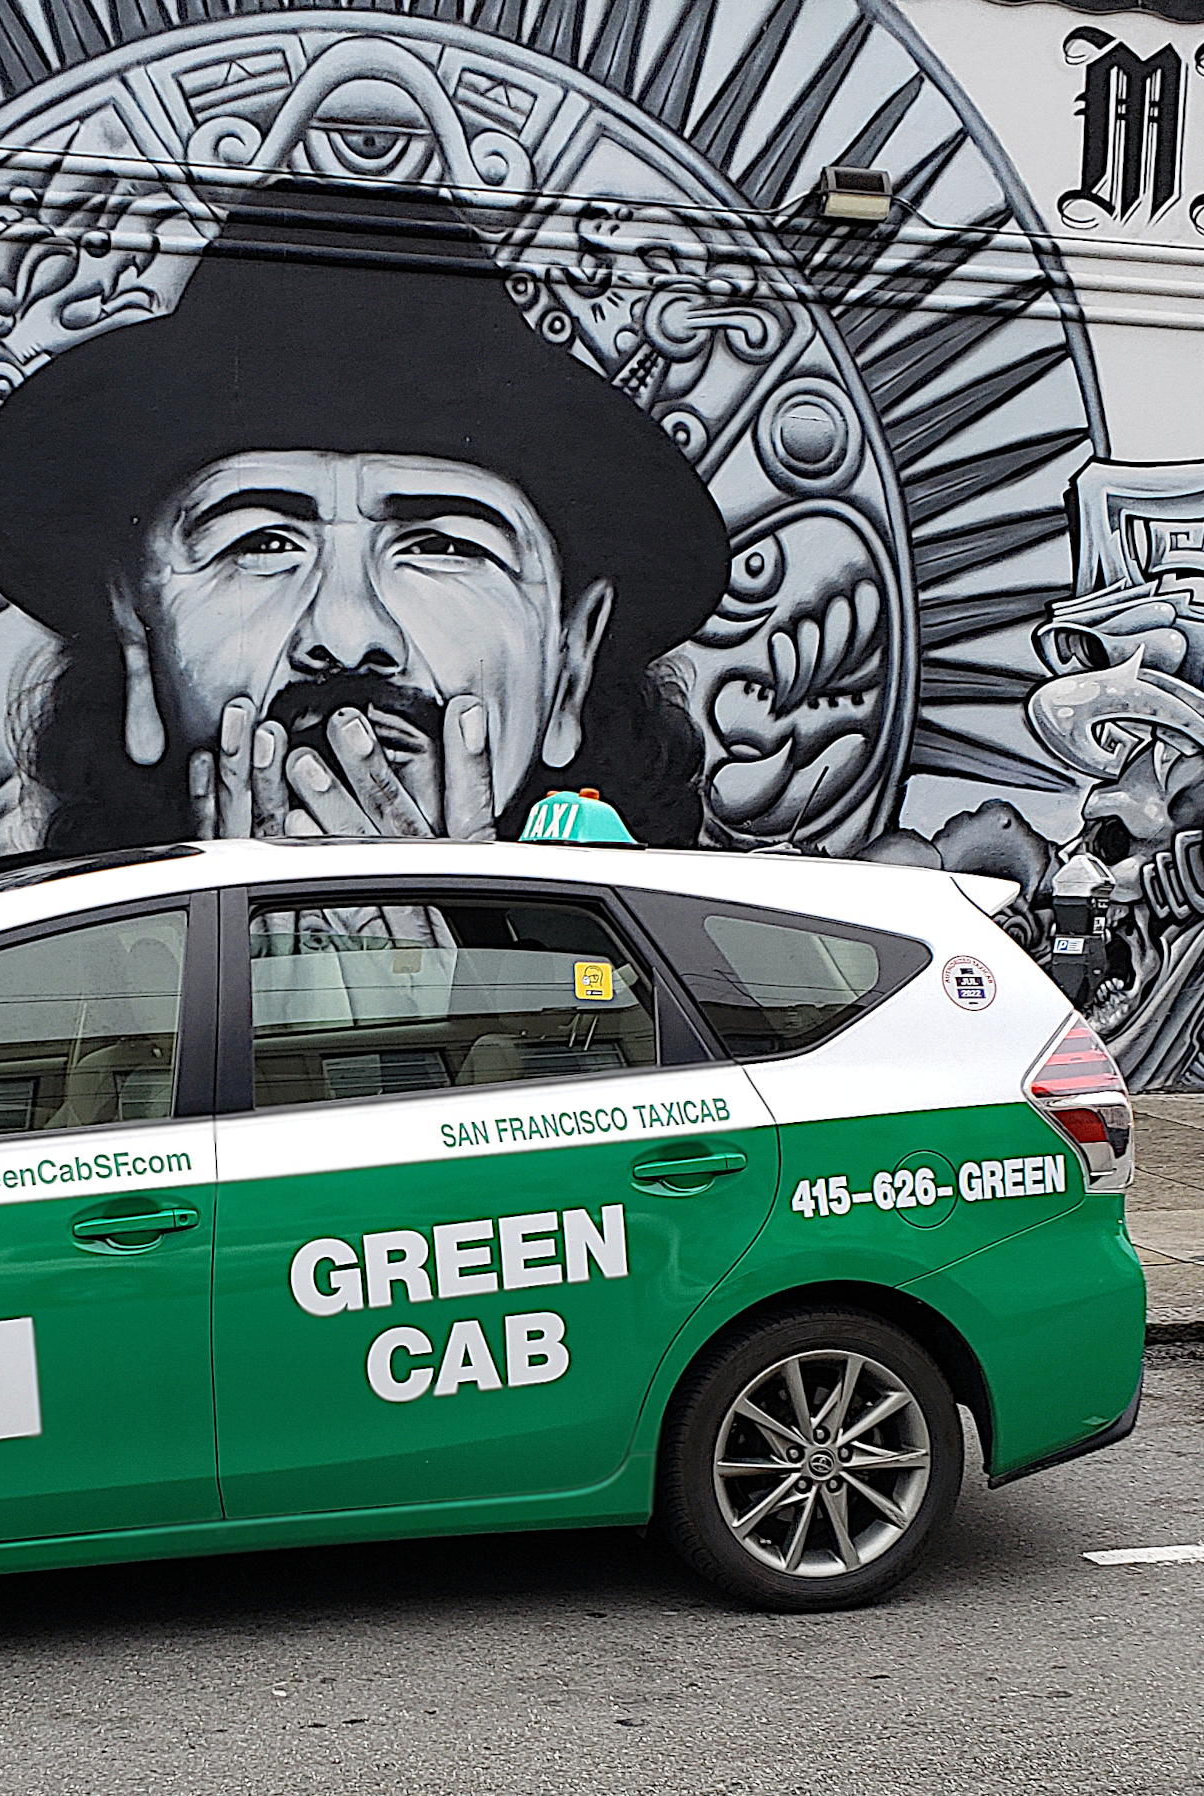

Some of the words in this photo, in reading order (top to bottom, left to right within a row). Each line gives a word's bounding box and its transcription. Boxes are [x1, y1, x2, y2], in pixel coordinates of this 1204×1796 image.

[523, 802, 580, 839] TAXI
[960, 977, 979, 986] JUL
[960, 989, 982, 997] 2022
[440, 1121, 490, 1148] SAN
[495, 1107, 628, 1143] FRANCISCO
[632, 1098, 731, 1129] TAXICAB
[290, 1203, 629, 1317] GREEN
[366, 1311, 570, 1403] CAB
